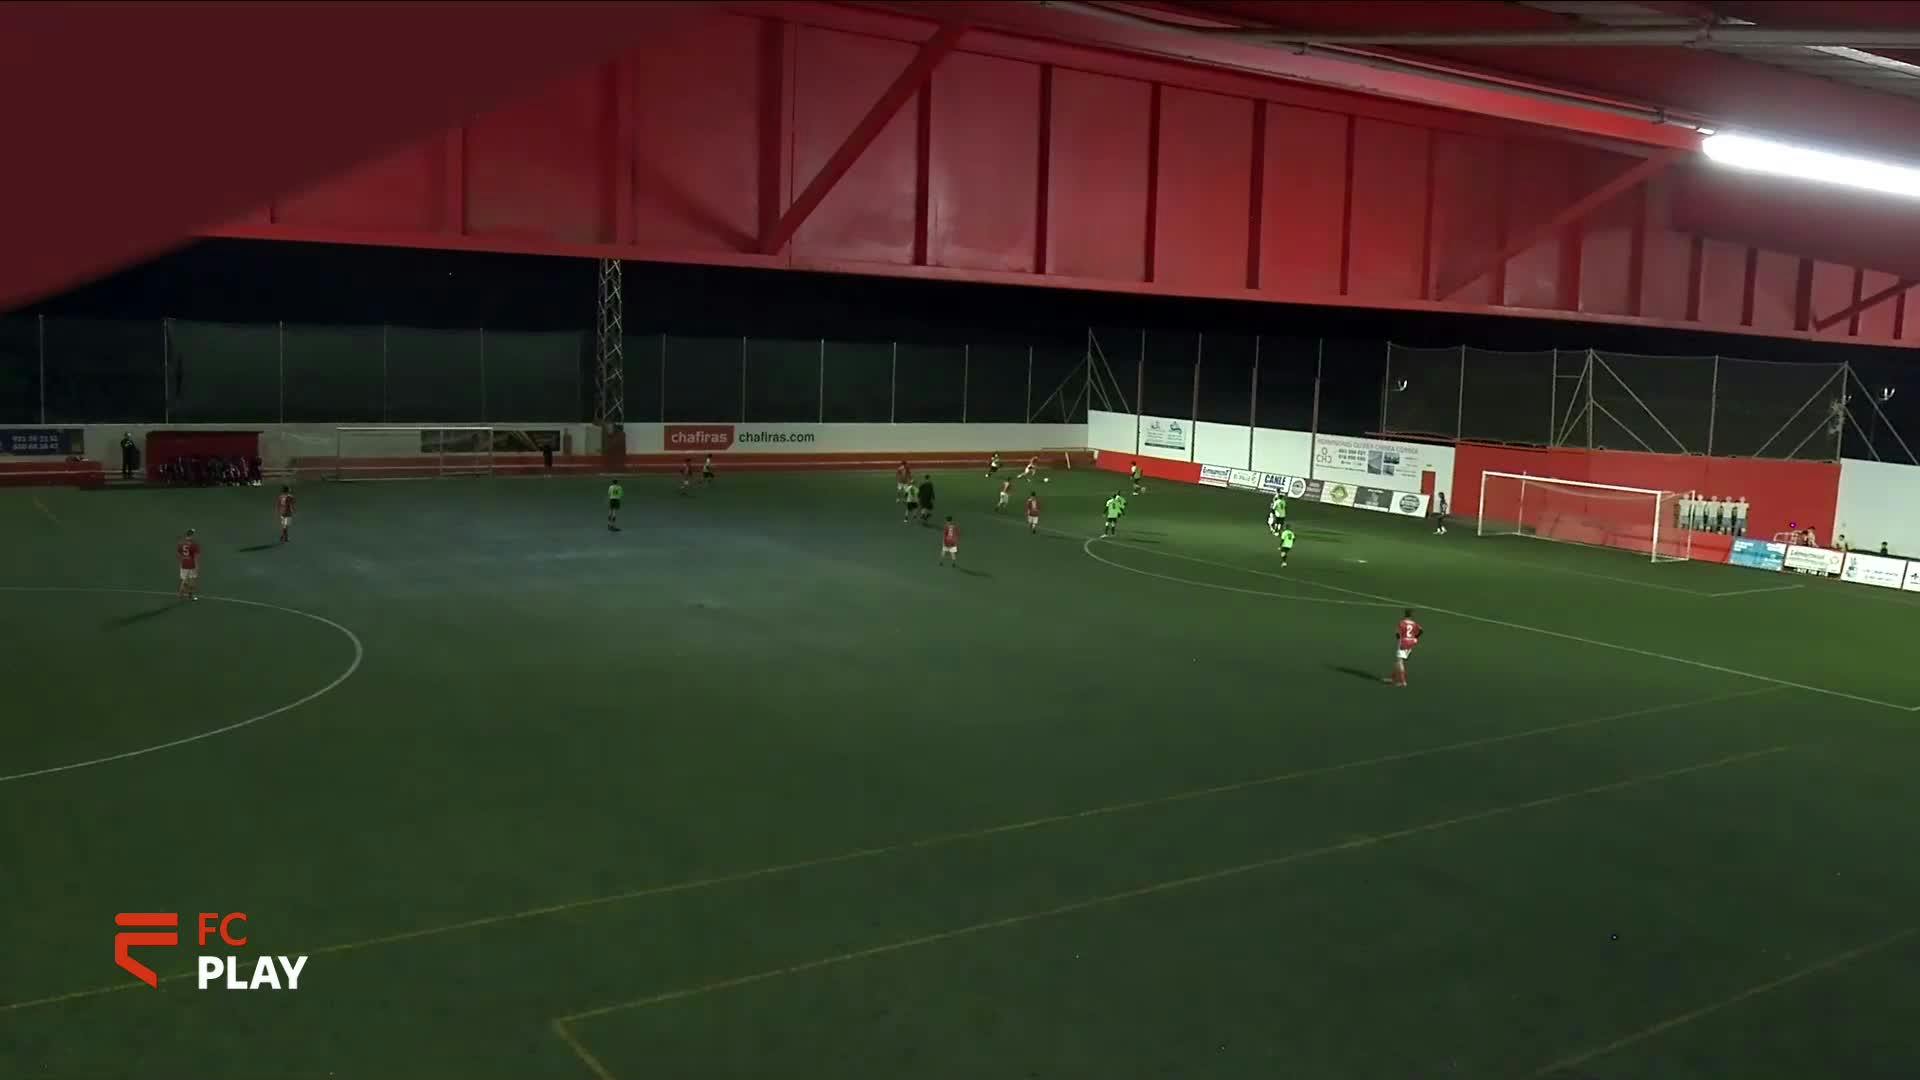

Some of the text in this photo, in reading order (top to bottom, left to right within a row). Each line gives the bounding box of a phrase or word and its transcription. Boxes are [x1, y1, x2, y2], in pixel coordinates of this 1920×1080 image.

[671, 431, 728, 443] chafiras
[738, 431, 815, 443] chafiras.com
[1406, 624, 1413, 638] 2
